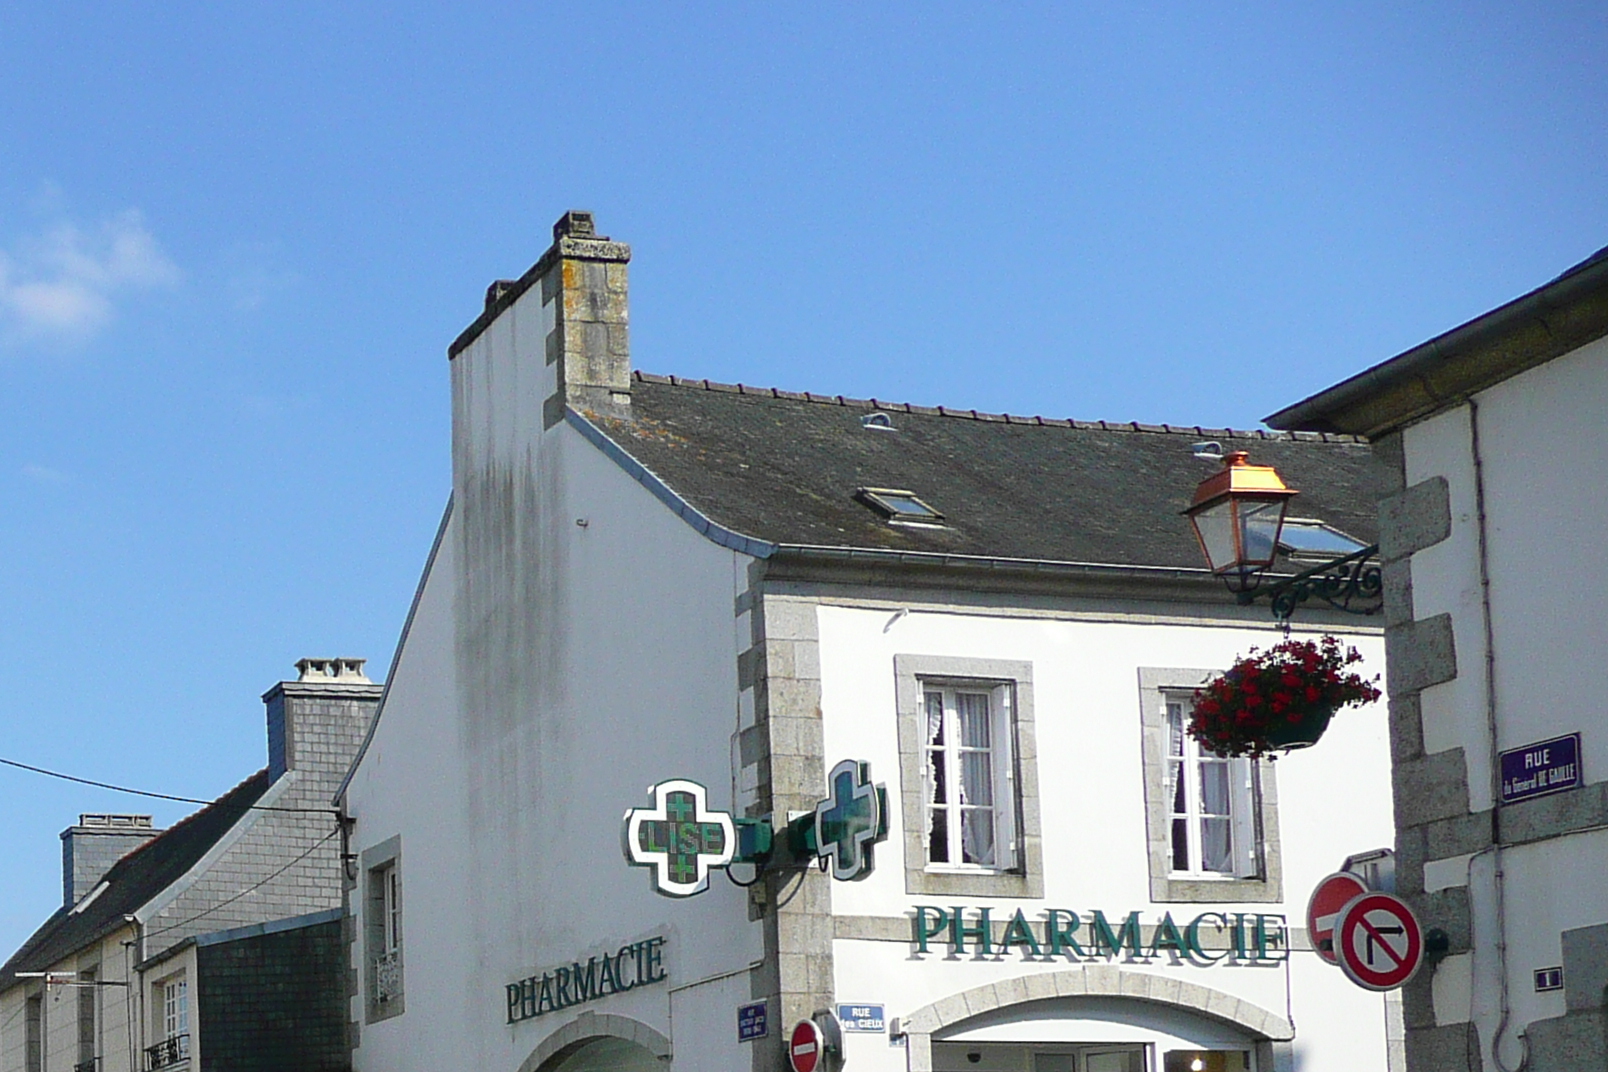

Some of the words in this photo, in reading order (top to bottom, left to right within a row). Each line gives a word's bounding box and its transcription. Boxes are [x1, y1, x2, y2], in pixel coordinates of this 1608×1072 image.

[1525, 749, 1550, 769] RUE
[648, 821, 722, 855] LISE
[911, 905, 1289, 961] PHARMACIE
[505, 935, 668, 1024] PHARMACIE
[852, 1007, 871, 1018] RUE
[858, 1018, 884, 1029] CIEUX
